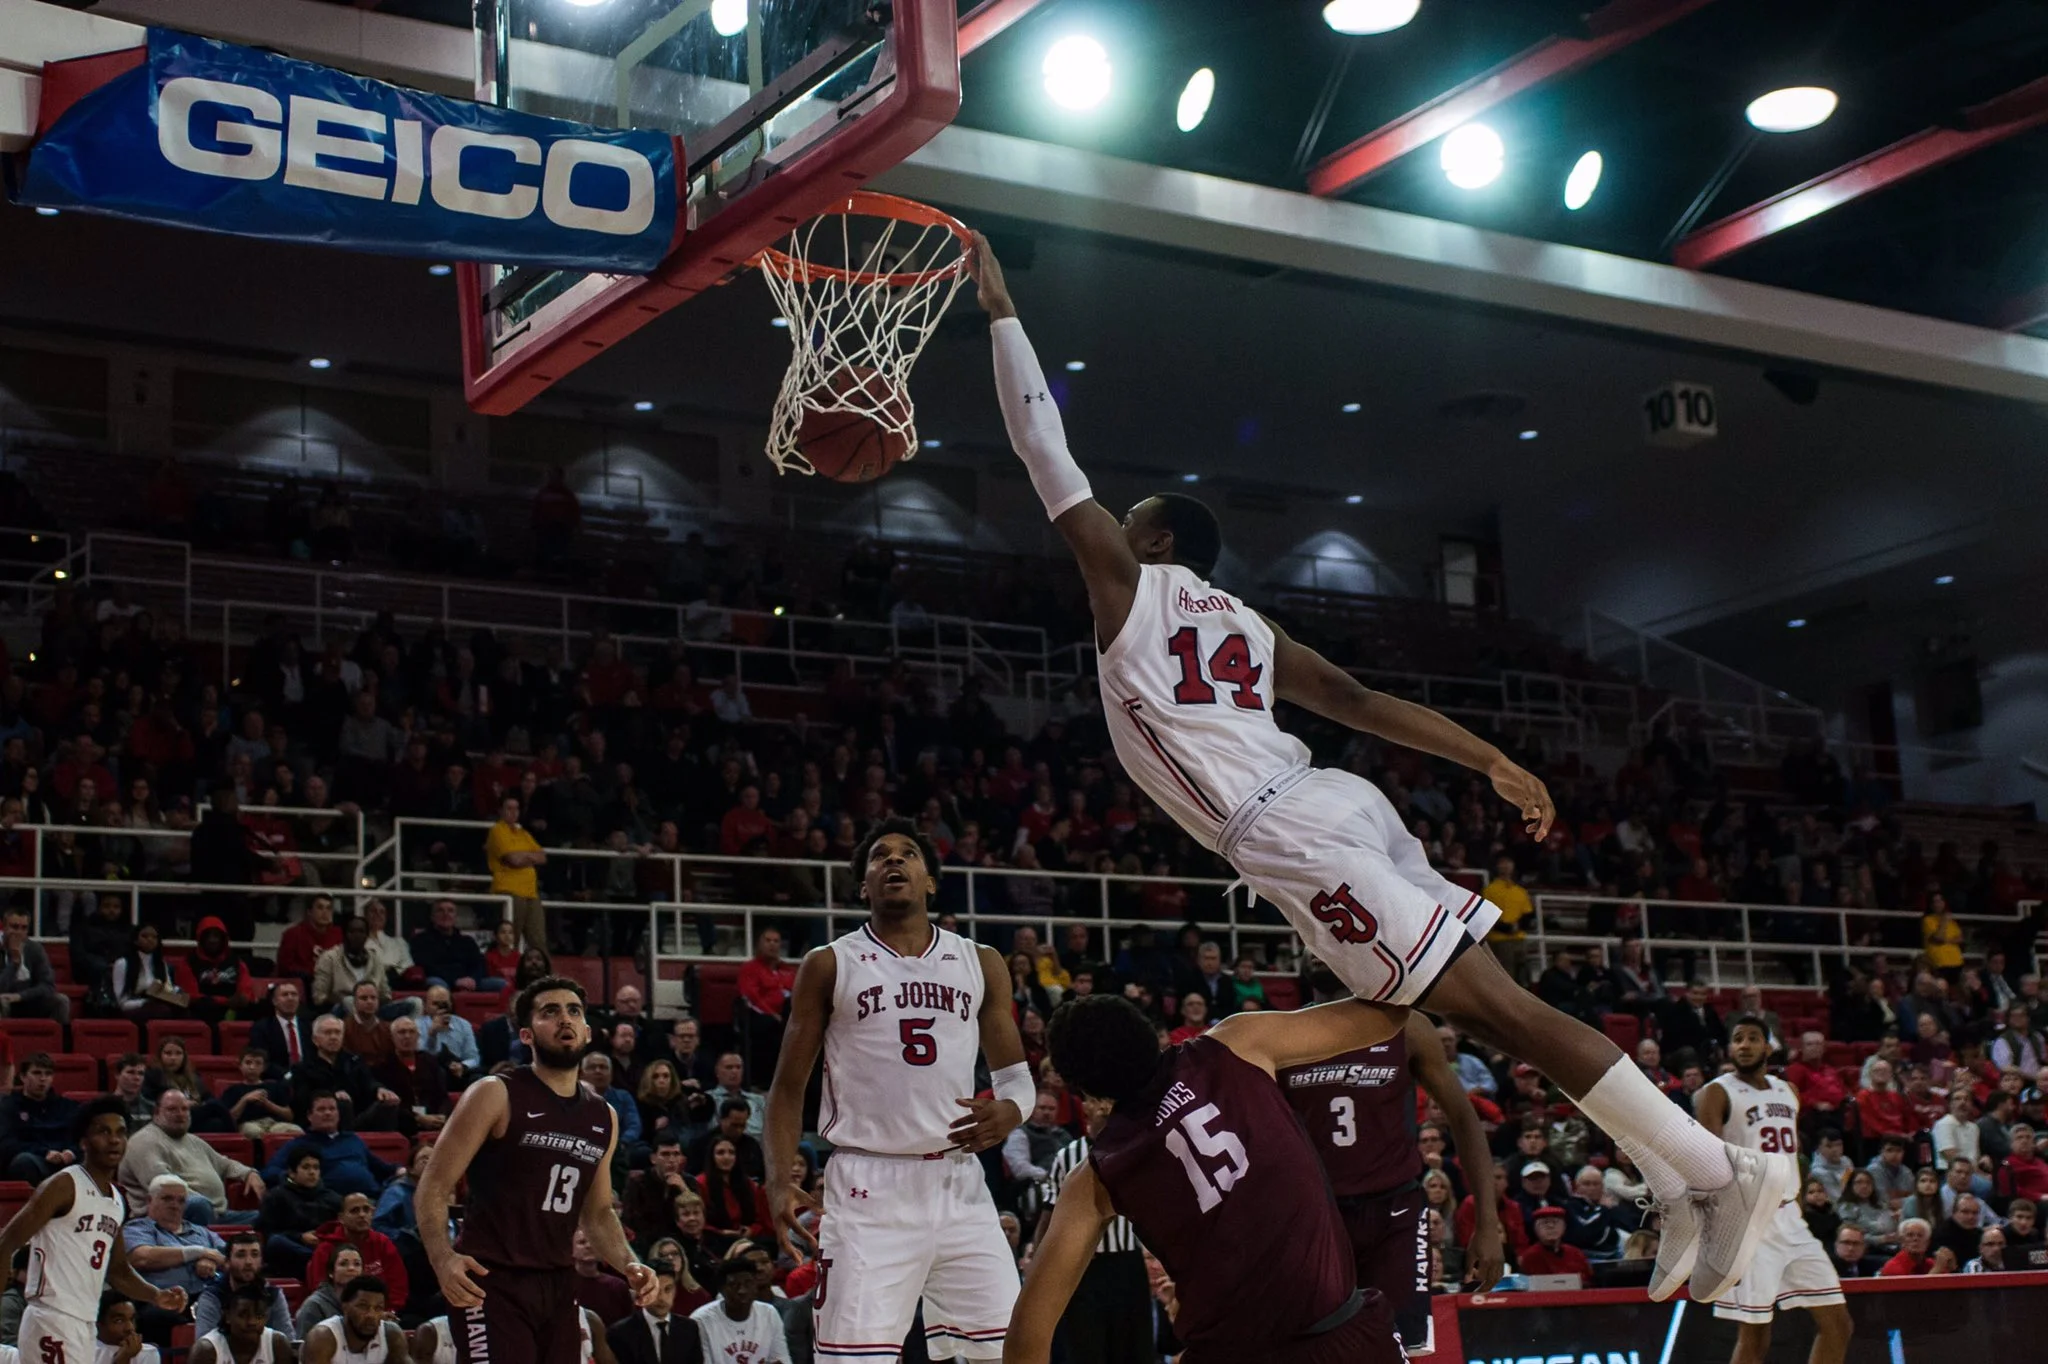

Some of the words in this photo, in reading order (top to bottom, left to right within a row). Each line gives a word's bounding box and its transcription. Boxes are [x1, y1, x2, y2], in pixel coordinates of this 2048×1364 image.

[157, 77, 656, 236] GEICO
[1645, 391, 1675, 432] 10
[1679, 390, 1713, 426] 10
[1178, 586, 1237, 614] HERON
[1168, 626, 1265, 711] 14
[857, 985, 887, 1021] ST.
[894, 981, 972, 1022] JOHN'S
[900, 1017, 937, 1066] 5
[1290, 1069, 1347, 1086] EASTERN
[1345, 1065, 1396, 1084] SHORE
[1155, 1081, 1196, 1127] JONES
[1329, 1096, 1357, 1147] 3
[522, 1133, 575, 1152] EASTERN
[1165, 1102, 1250, 1214] 15
[1760, 1127, 1796, 1153] 30
[541, 1163, 580, 1214] 13
[90, 1240, 107, 1270] 3
